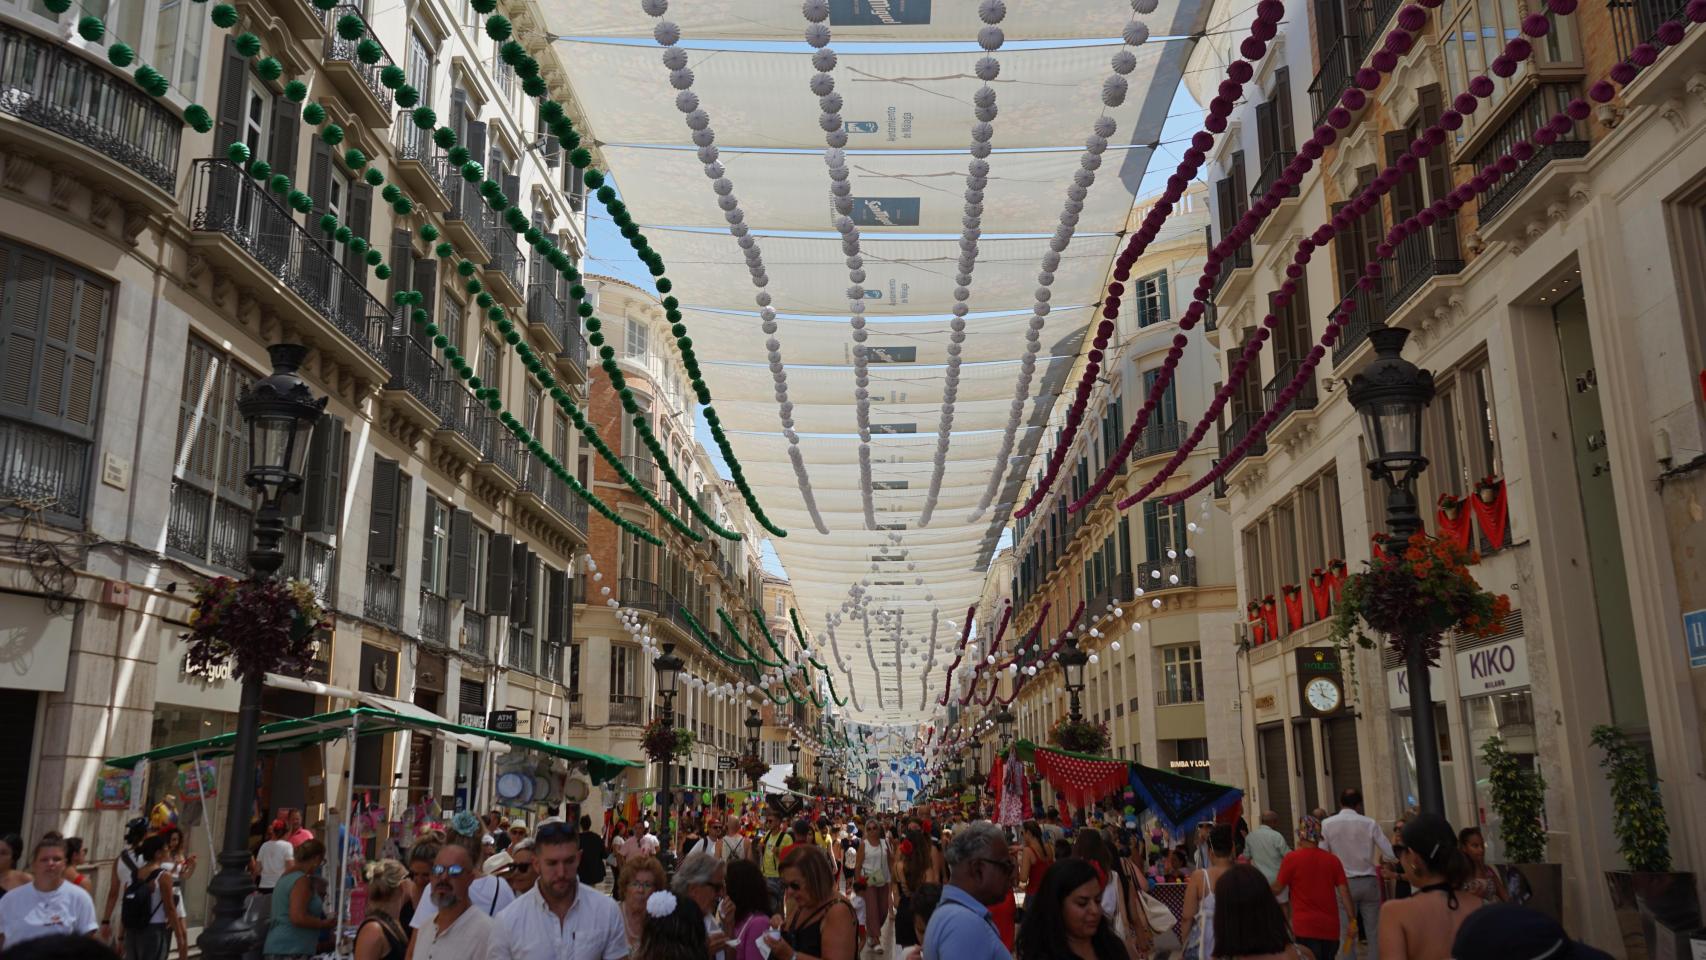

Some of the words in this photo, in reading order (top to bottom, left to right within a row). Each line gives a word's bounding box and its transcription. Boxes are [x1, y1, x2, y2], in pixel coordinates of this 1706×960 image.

[1469, 644, 1515, 680] KIKO
[1484, 679, 1506, 690] MILANO
[497, 713, 513, 722] ATM
[1170, 760, 1189, 768] BIMBA
